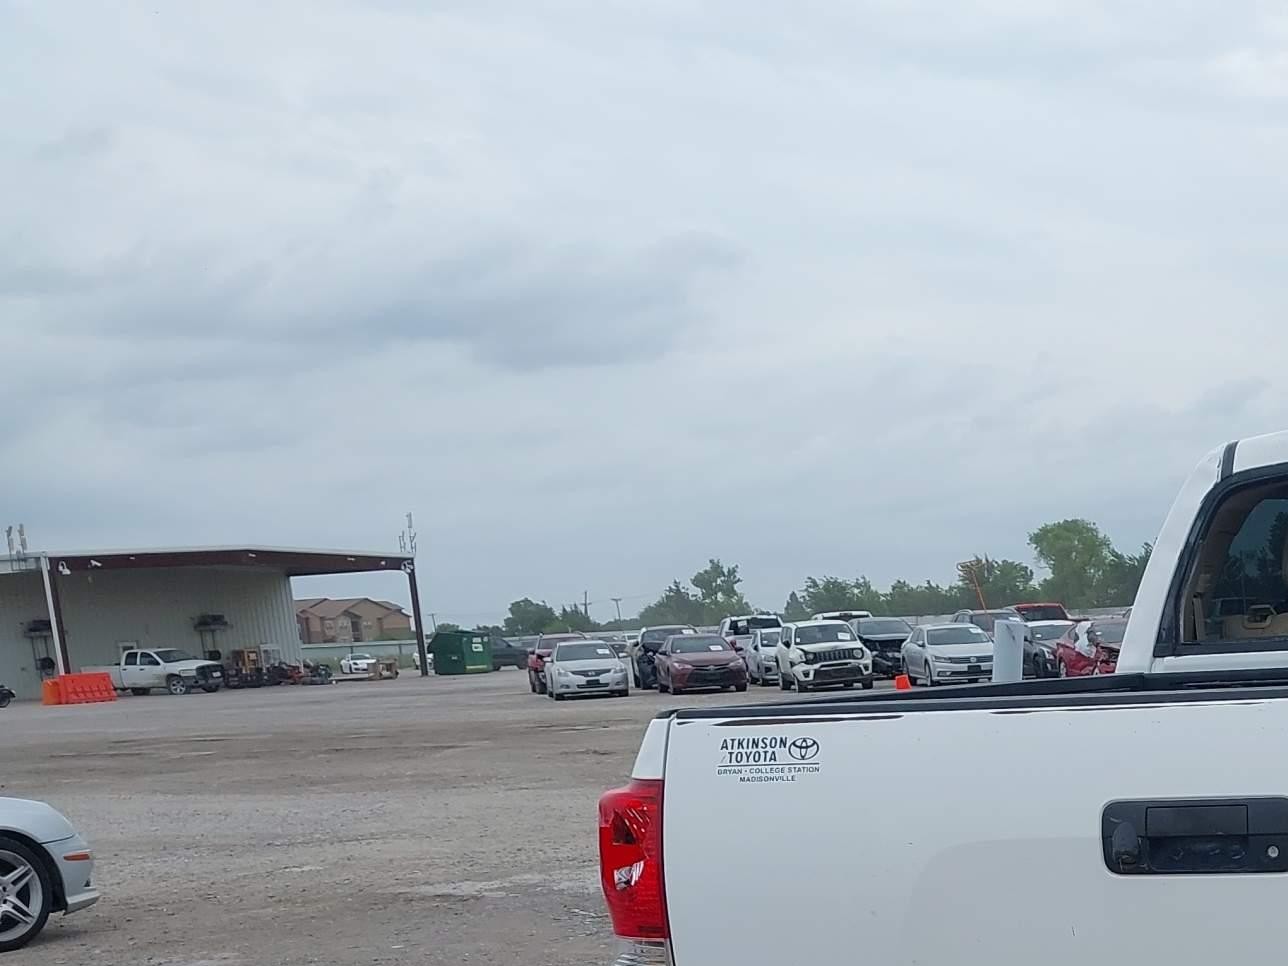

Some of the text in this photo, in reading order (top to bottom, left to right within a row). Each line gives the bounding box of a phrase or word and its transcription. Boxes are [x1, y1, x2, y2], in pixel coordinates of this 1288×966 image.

[720, 736, 788, 750] ATKINSON
[727, 750, 777, 764] TOYOTA
[749, 766, 786, 775] COLLEGE
[788, 766, 820, 774] STATION
[739, 774, 797, 783] MADISONVILLE
